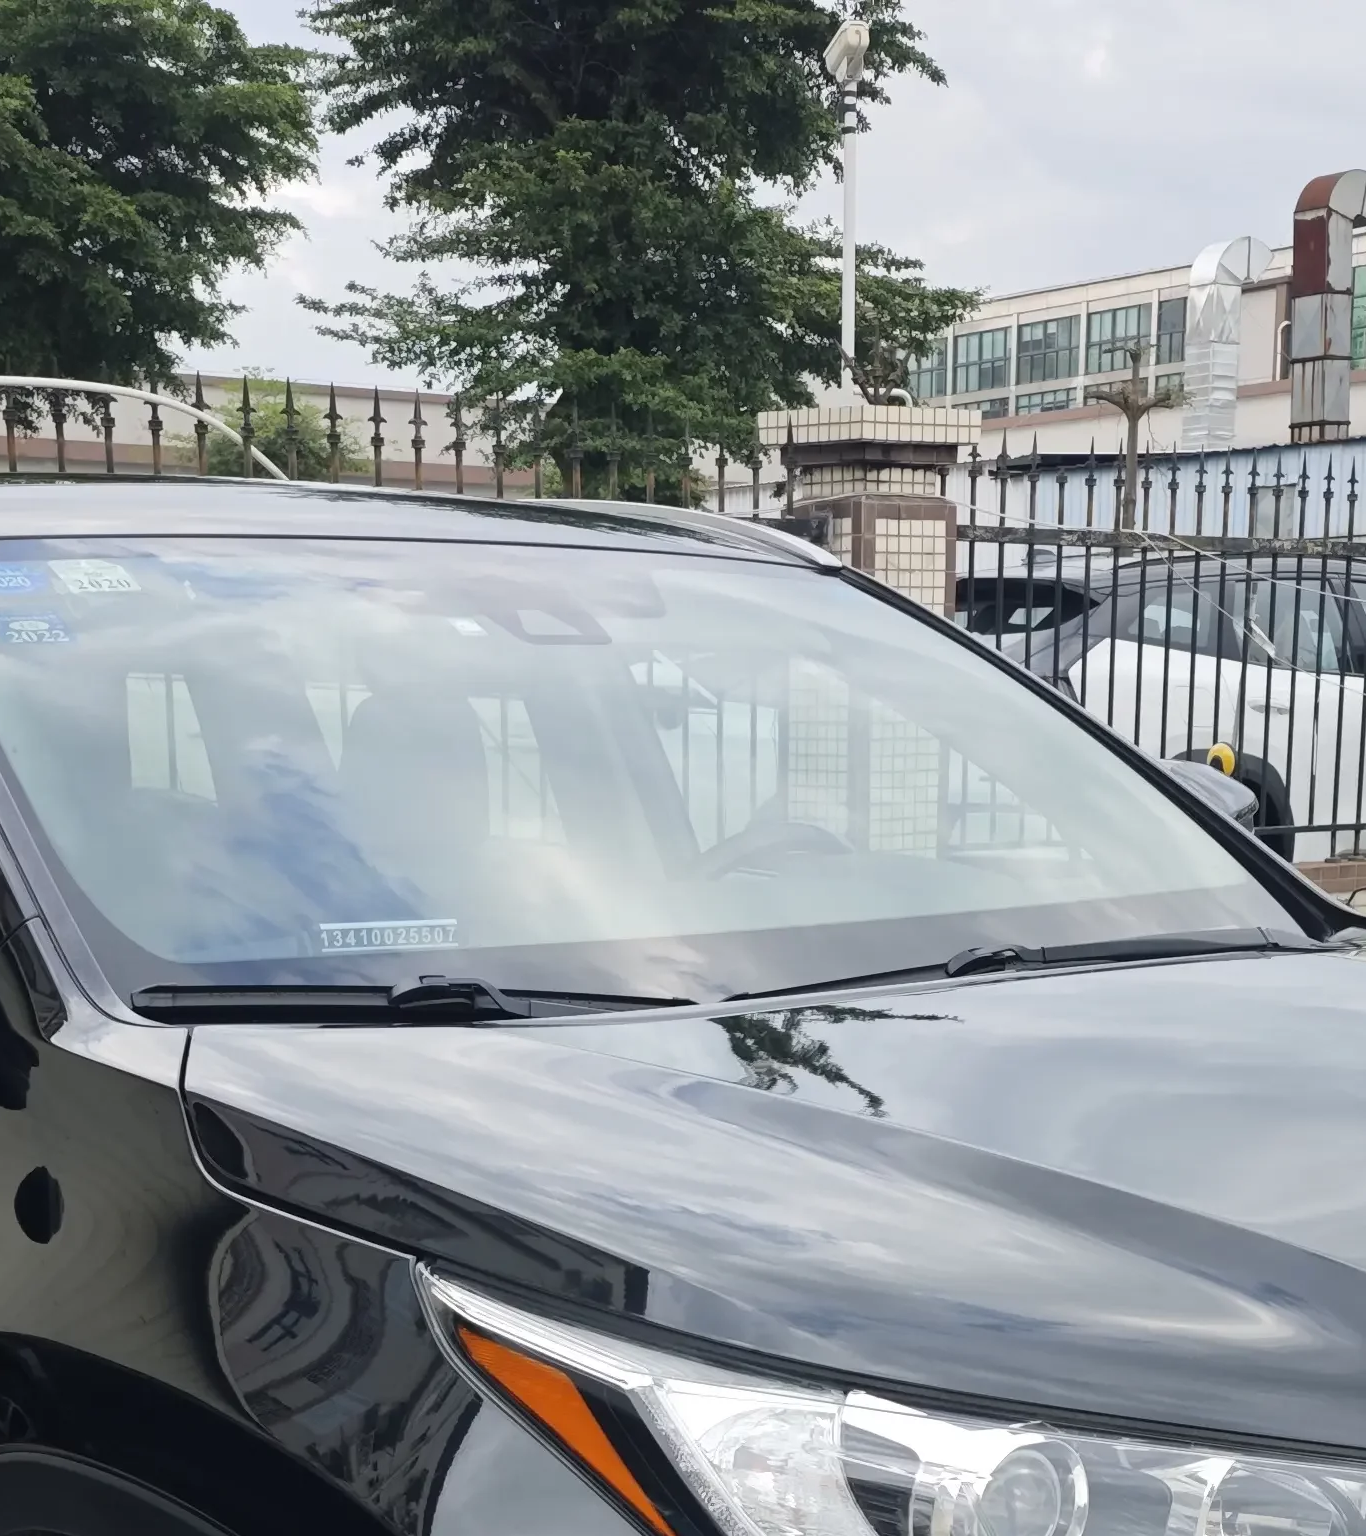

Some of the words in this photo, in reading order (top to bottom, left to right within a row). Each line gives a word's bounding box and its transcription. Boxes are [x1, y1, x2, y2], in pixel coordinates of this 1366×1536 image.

[74, 579, 131, 589] 2020
[5, 630, 70, 643] 2022
[320, 927, 457, 947] 13410025507
